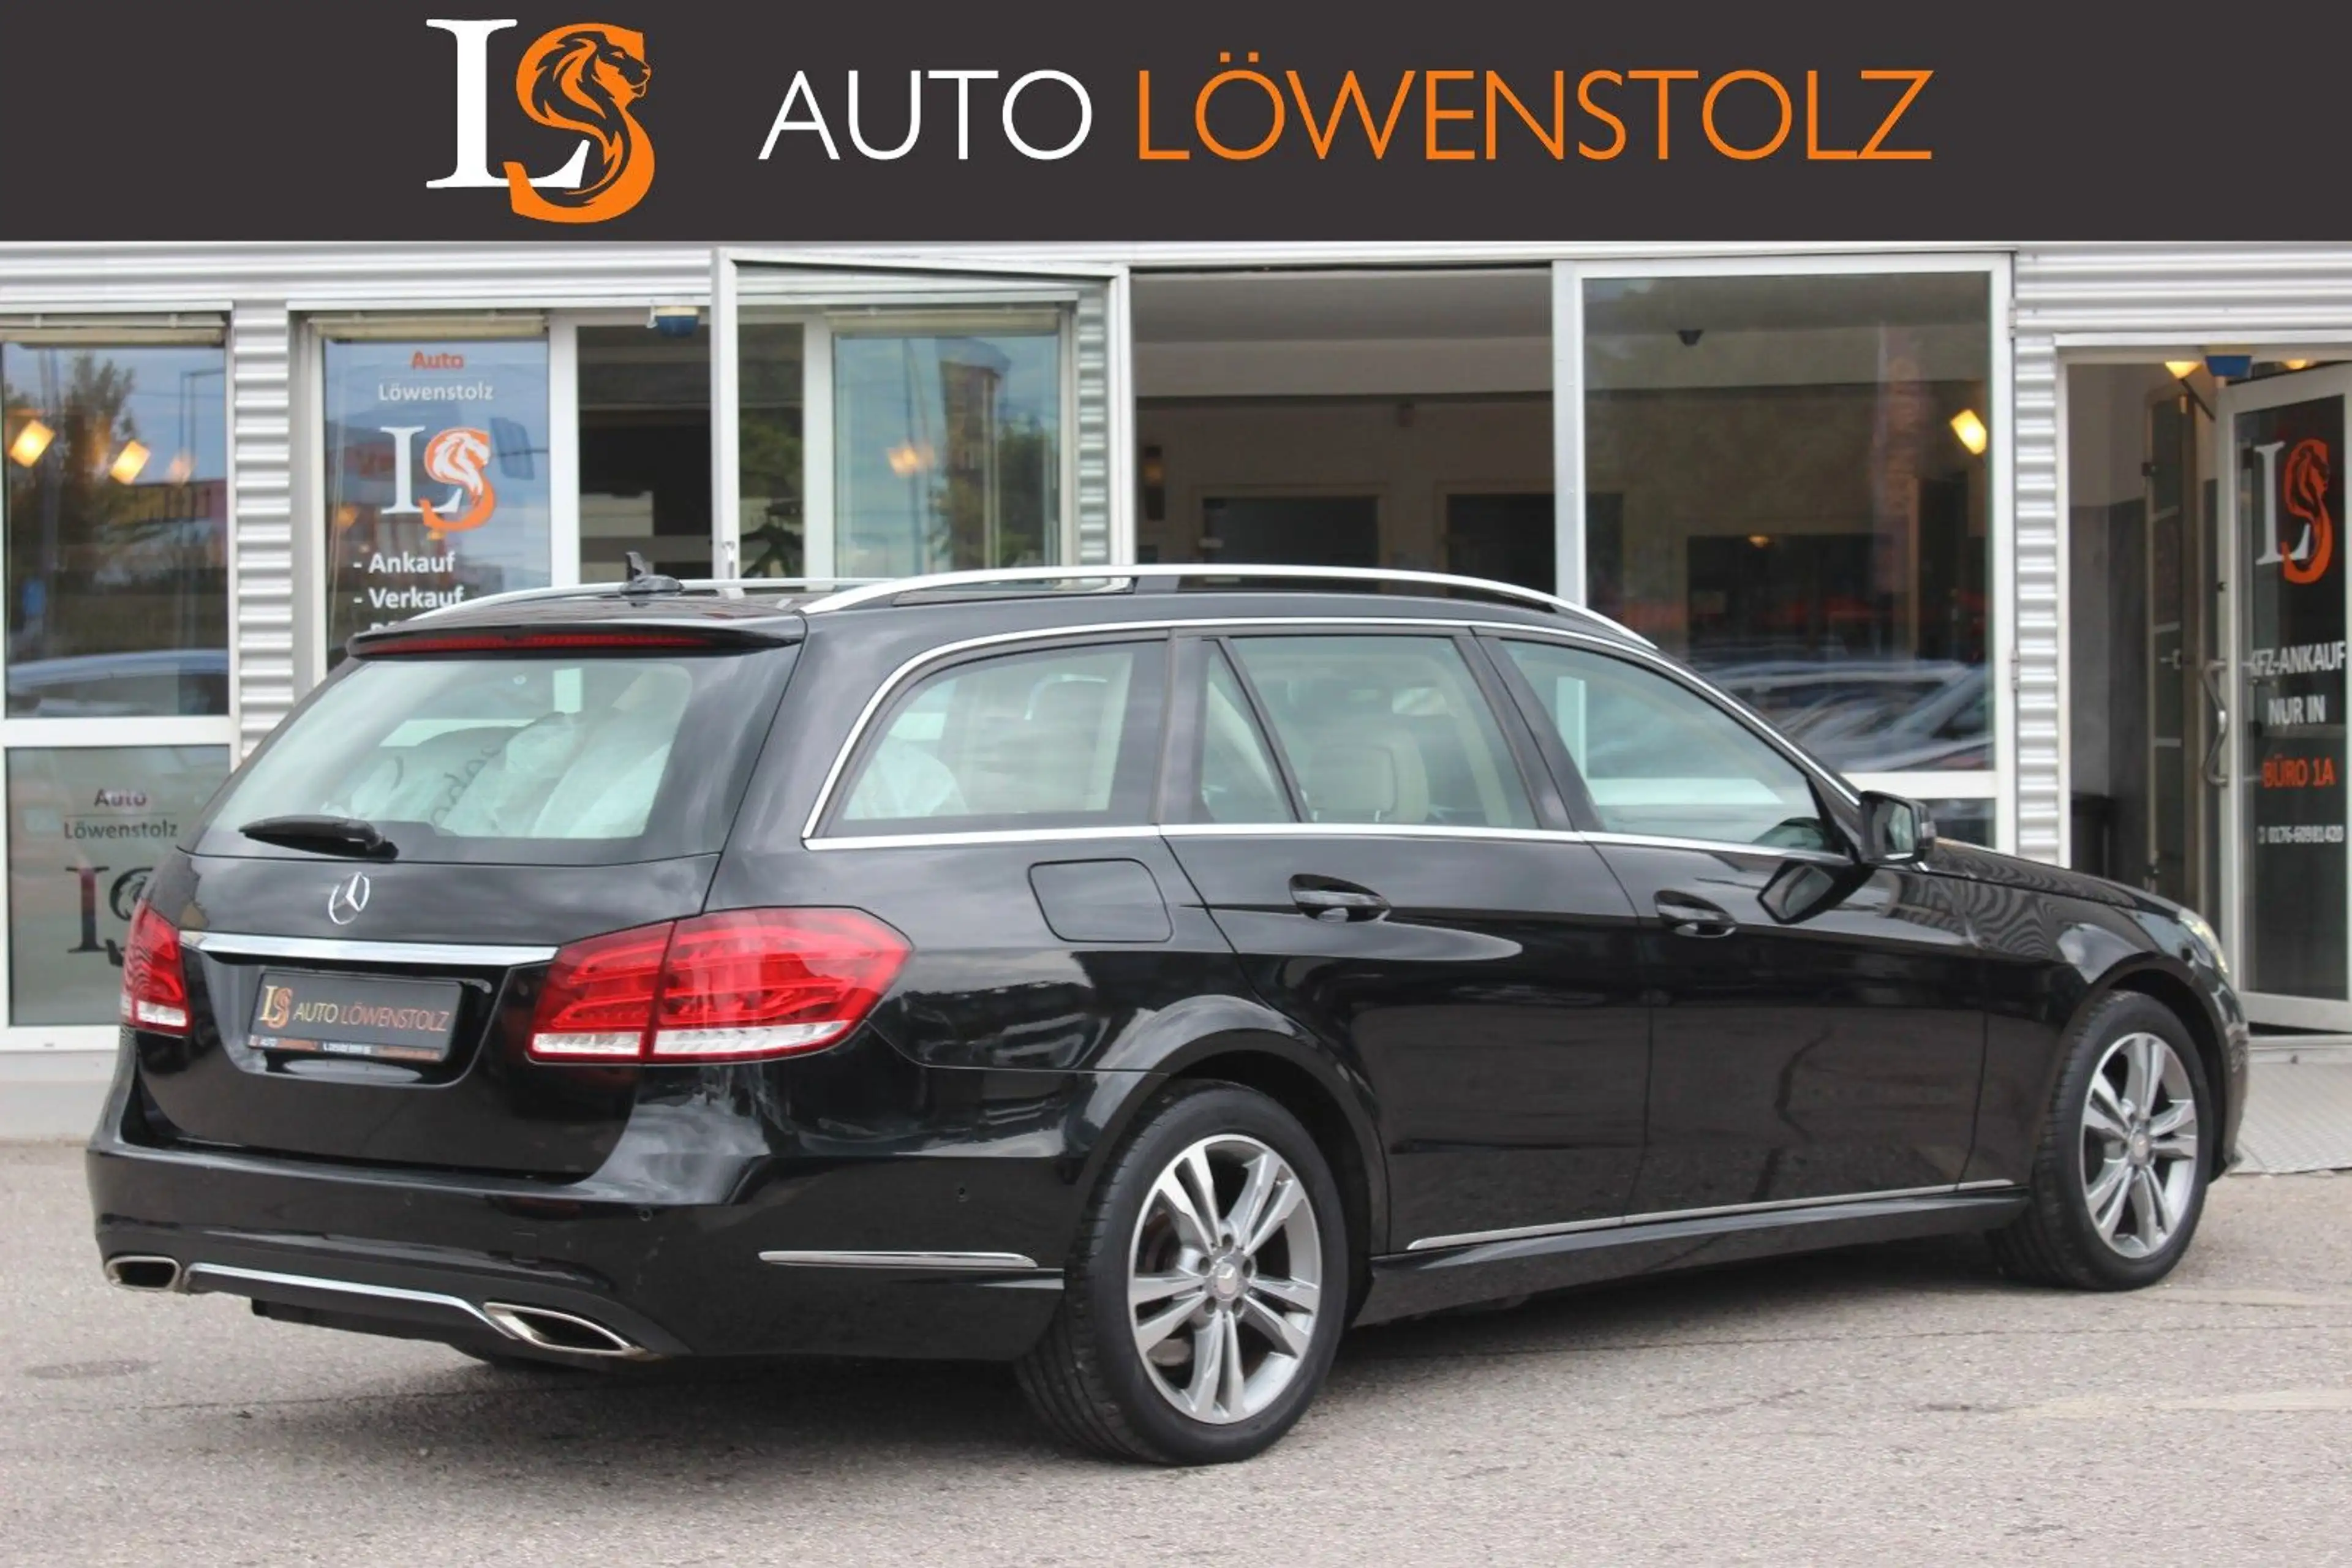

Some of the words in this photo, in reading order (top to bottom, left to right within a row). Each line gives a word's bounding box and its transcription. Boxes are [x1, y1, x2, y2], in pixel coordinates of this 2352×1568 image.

[411, 351, 464, 370] Auto
[378, 381, 494, 401] Löwenstolz
[368, 551, 456, 573] Ankauf
[368, 585, 465, 609] Verkauf
[2249, 641, 2346, 677] KFZ-ANKAUF
[2268, 696, 2304, 726] NUR
[2306, 694, 2326, 724] IN
[2261, 754, 2309, 788] BÜRO
[2313, 757, 2337, 786] 1A
[94, 789, 148, 807] Auto
[64, 818, 179, 840] Löwenstolz
[292, 1001, 340, 1024] AUTO
[340, 1001, 450, 1031] LÖWENSTOLZ
